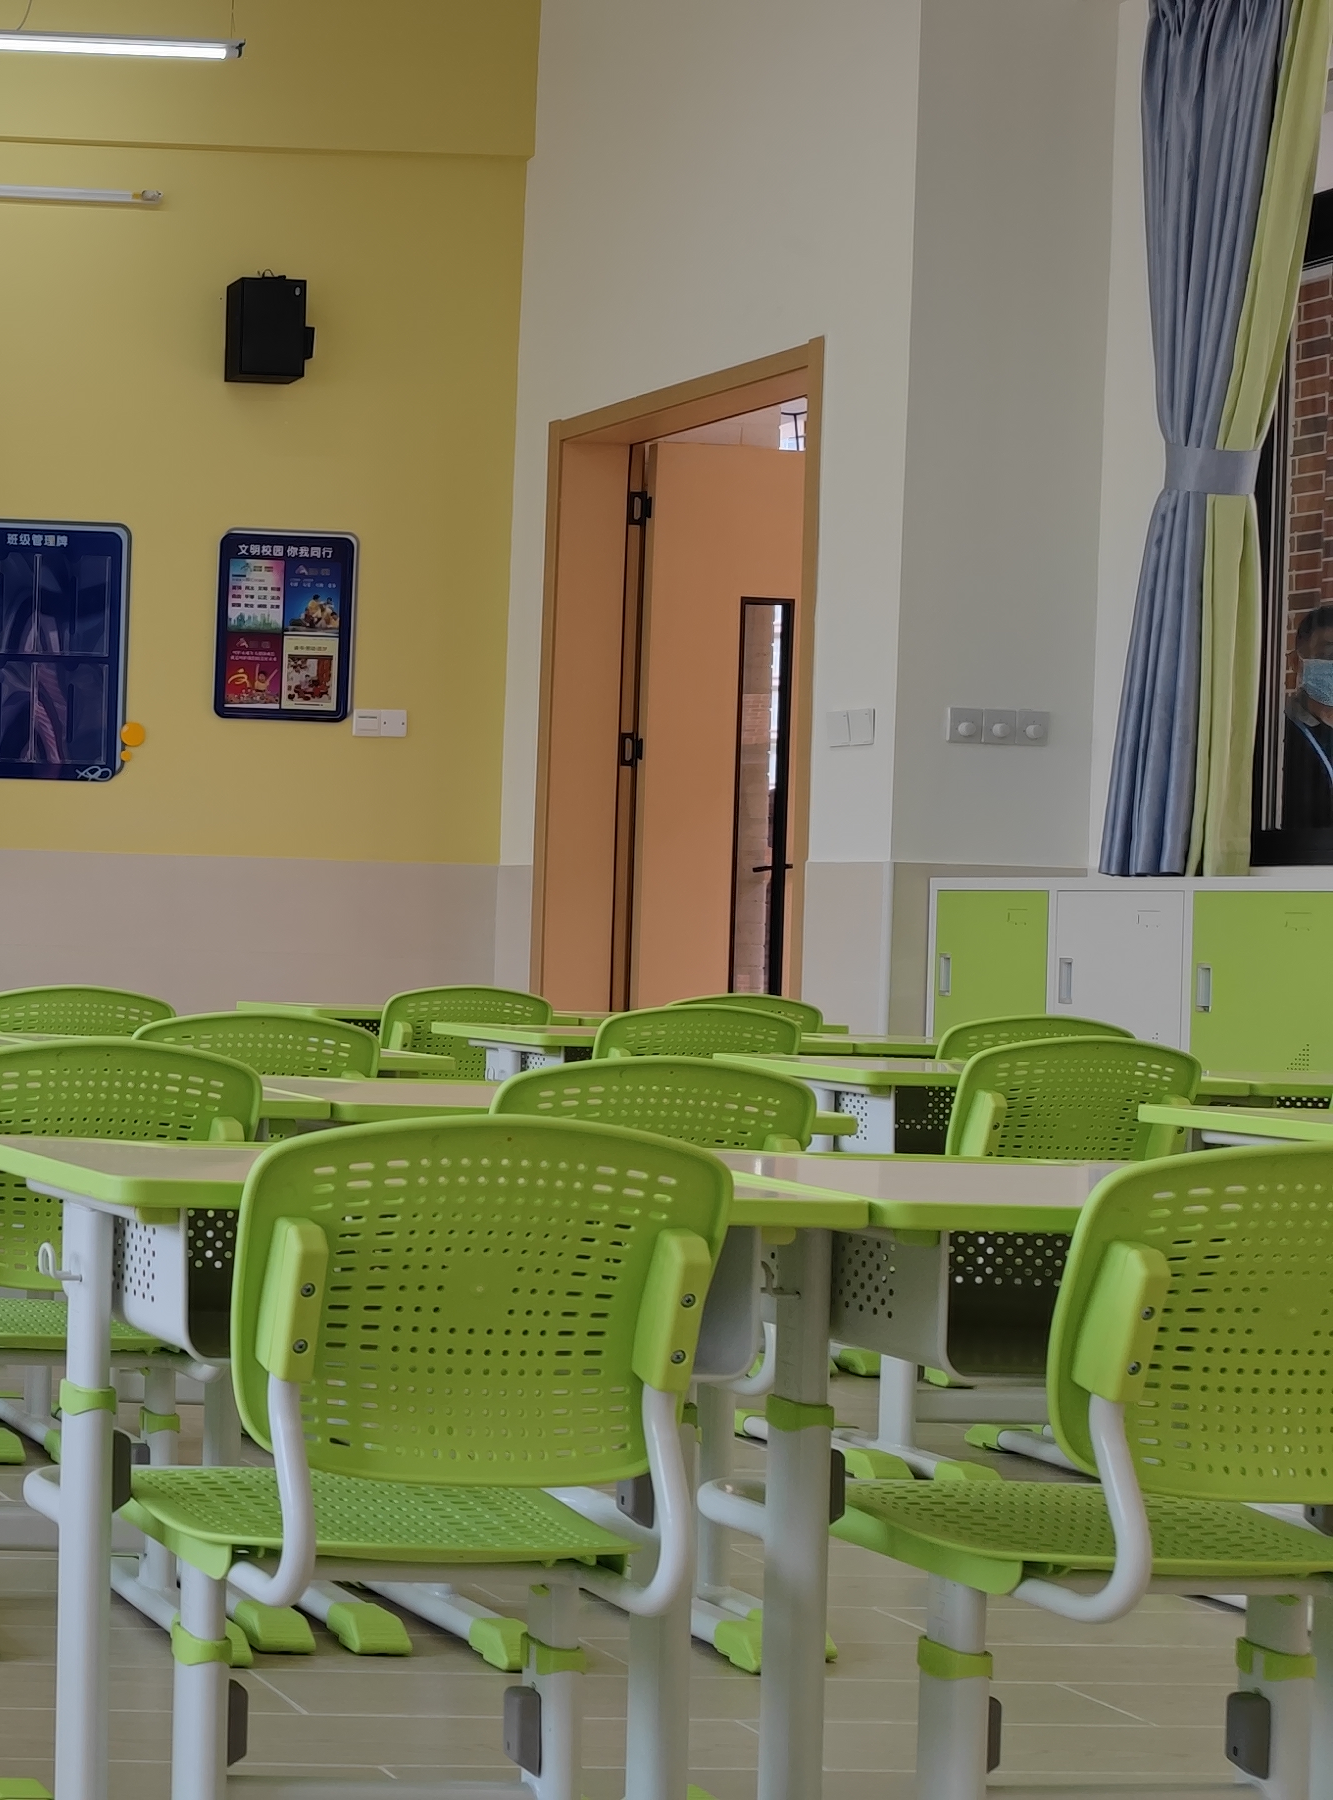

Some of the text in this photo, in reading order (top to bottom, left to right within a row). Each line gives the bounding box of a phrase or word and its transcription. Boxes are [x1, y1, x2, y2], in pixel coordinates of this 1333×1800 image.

[6, 533, 68, 548] 班级管理牌
[237, 544, 334, 559] 文明校园 你我同行
